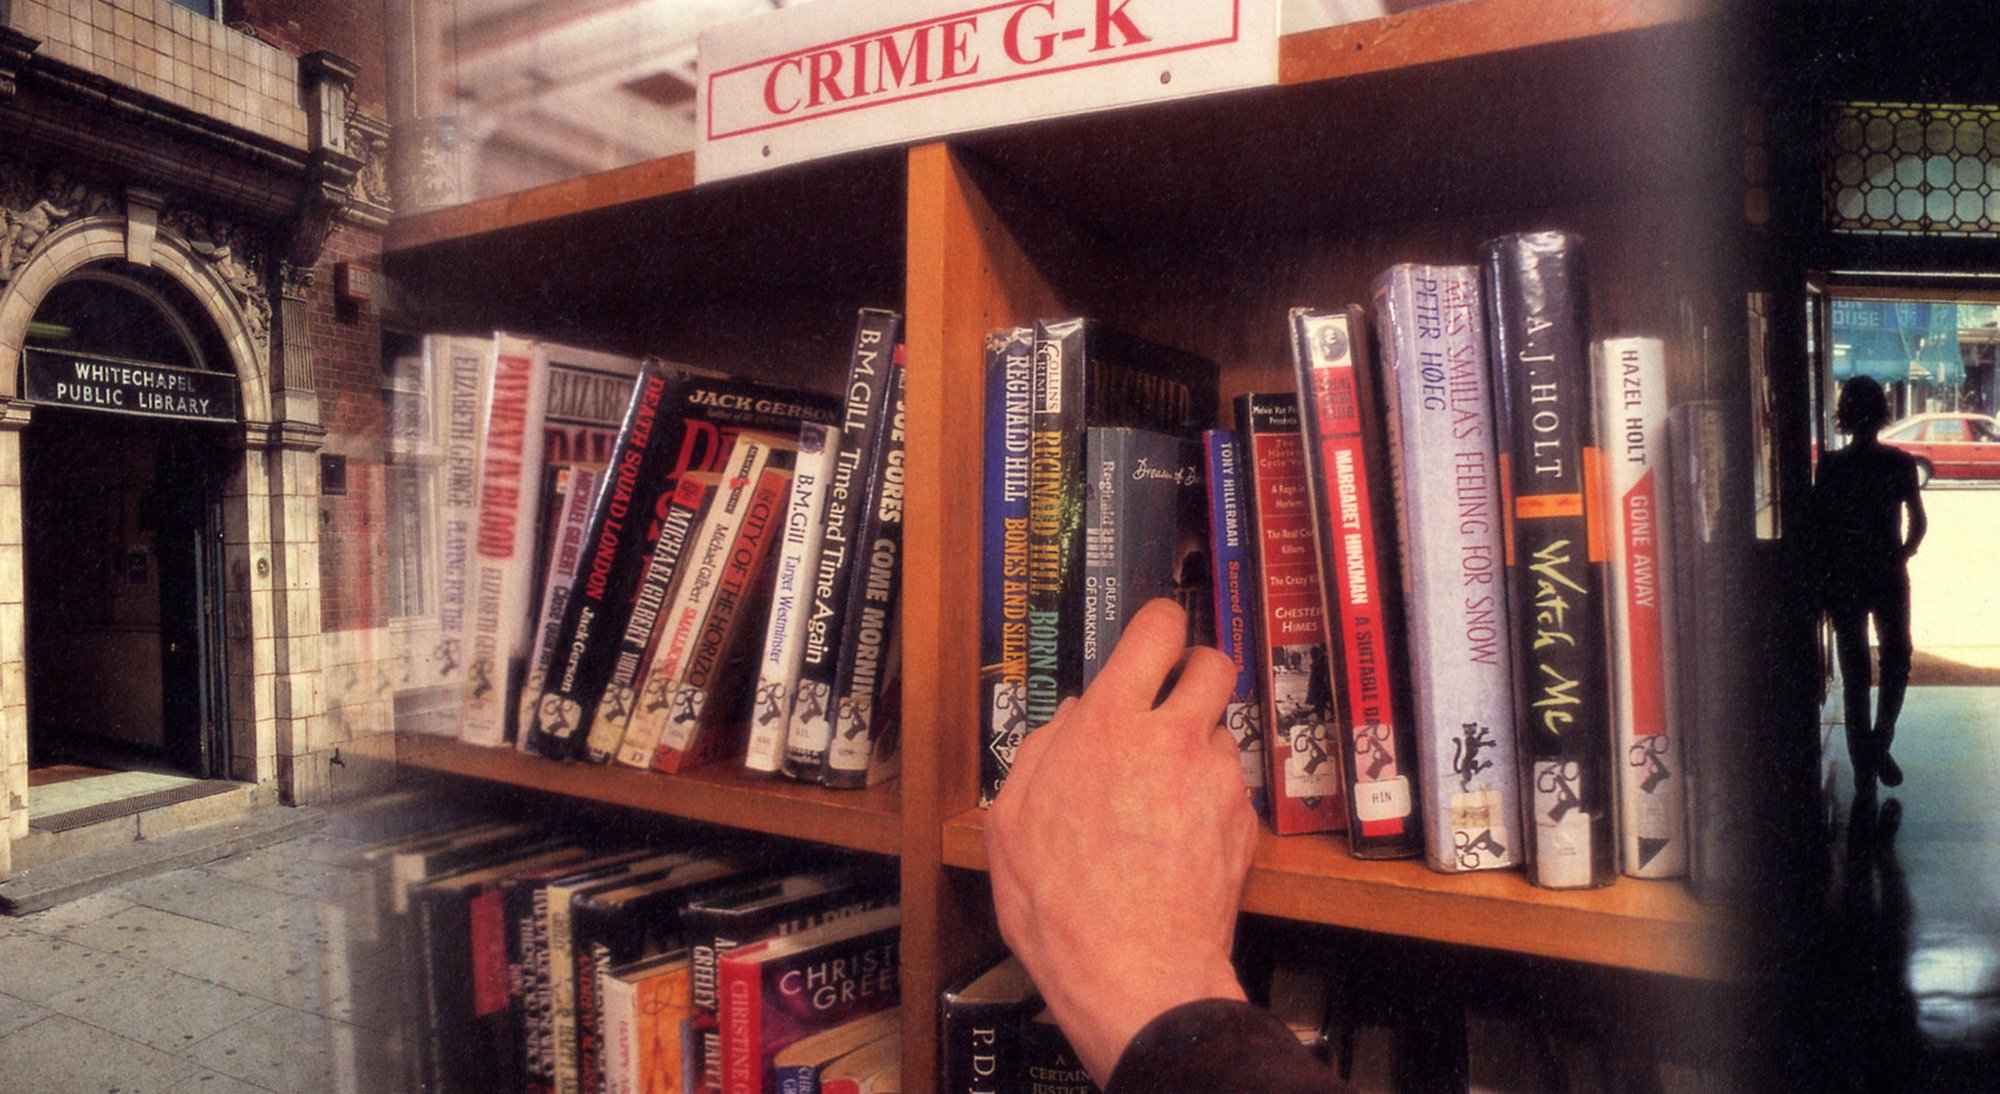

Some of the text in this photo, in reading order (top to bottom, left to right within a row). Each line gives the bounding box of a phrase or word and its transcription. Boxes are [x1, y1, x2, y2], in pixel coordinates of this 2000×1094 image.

[763, 0, 1152, 115] CRIME G-K
[1414, 276, 1446, 411] PETER HØEG
[1832, 310, 1880, 327] OUSE
[56, 382, 210, 415] PUBLIC LIBRARY
[75, 362, 196, 393] WHITECHAPEL
[451, 356, 479, 441] ELIZABETH
[487, 354, 533, 455] PAYMENT
[548, 368, 636, 427] ELIZABE
[688, 389, 838, 422] JACK GERSON
[1041, 342, 1060, 411] COLLINS
[1448, 345, 1482, 440] SMILLA'S
[1622, 350, 1647, 465] HAZEL HOLT
[448, 446, 475, 508] GEORGE
[483, 457, 521, 479] IN
[877, 452, 905, 523] GORES
[1031, 430, 1062, 536] REGINALD
[1220, 442, 1233, 475] TONY
[1334, 450, 1361, 530] MARGARET
[476, 483, 520, 559] BLOOD
[742, 498, 772, 547] CITY
[806, 329, 881, 664] B.M.GILL Time and Time Again
[1003, 354, 1030, 687] REGINALD HILL BONES AND SILENC
[1101, 460, 1116, 524] Reginald
[1223, 479, 1238, 547] HILLERMAN
[1455, 452, 1489, 536] FEELING
[561, 376, 665, 692] DEATH SQUAD LONDON Jack Gerson
[648, 507, 693, 588] MICHAEL
[703, 523, 730, 567] Michael
[730, 549, 753, 577] OF
[1461, 544, 1491, 586] FOR
[1630, 495, 1655, 608] GONE AWAY
[688, 566, 713, 604] Gilbert
[716, 579, 743, 613] THE
[769, 473, 815, 665] B.M.Gill Target Westminster
[866, 538, 896, 603] COME
[1105, 576, 1116, 621] DREAM
[1228, 560, 1243, 614] Sacred
[1344, 534, 1369, 605] HINXMAN
[623, 586, 665, 649] GILBERT
[1029, 611, 1059, 670] BORN
[1084, 576, 1097, 660] OF DARKNESS
[1275, 606, 1324, 620] CHESTER
[1282, 620, 1318, 633] HIMES
[1465, 597, 1497, 665] SNOW
[1529, 540, 1588, 734] Watch Me
[689, 612, 731, 688] HORIZO
[851, 607, 886, 699] MORNIN
[1355, 631, 1381, 702] SUITABLE
[1363, 705, 1384, 726] DA
[693, 945, 715, 1010] GREELEY
[780, 945, 894, 996] CHRIST
[812, 969, 893, 1010] GREE
[730, 980, 750, 1082] CHRISTINE
[1055, 1055, 1066, 1066] A
[1029, 1066, 1089, 1082] CERTAIN
[1032, 1082, 1087, 1094] JUSTICE
